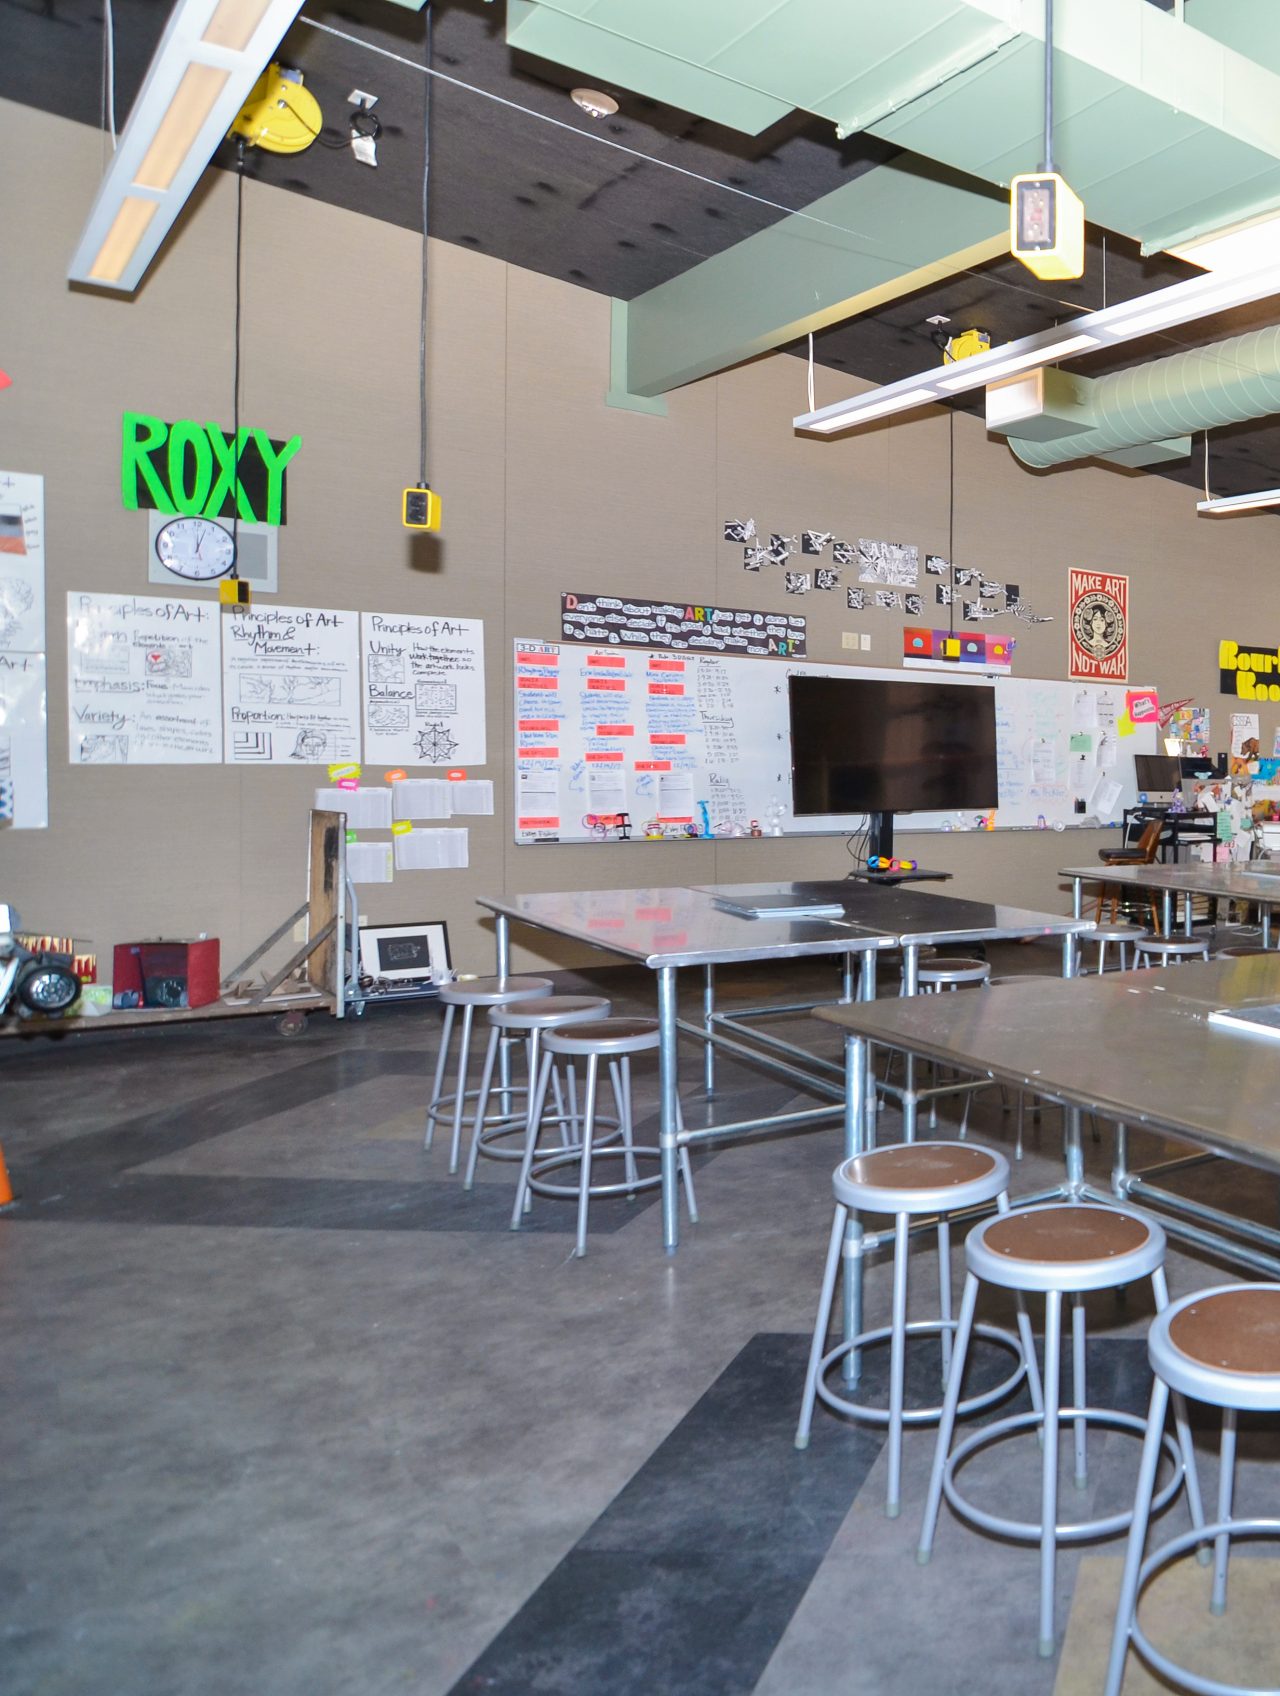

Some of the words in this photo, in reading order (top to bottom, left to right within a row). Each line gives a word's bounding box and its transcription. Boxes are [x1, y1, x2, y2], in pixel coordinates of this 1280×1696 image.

[122, 410, 302, 526] ROXY
[1072, 573, 1102, 604] MAKE
[1104, 578, 1126, 608] ART
[80, 596, 152, 620] Priples
[156, 604, 174, 620] of
[232, 604, 293, 625] Principles
[296, 612, 314, 628] of
[316, 613, 344, 627] Art
[597, 598, 622, 608] think
[623, 606, 650, 614] about
[652, 606, 684, 618] making
[736, 614, 751, 622] get
[231, 624, 281, 646] Rhythm
[282, 626, 296, 640] &
[372, 616, 424, 636] Principles
[424, 621, 440, 637] of
[441, 622, 470, 636] Art
[564, 614, 604, 624] everyone
[606, 614, 626, 622] else
[628, 619, 656, 628] decide
[682, 622, 702, 631] good
[732, 627, 766, 638] whether
[768, 626, 785, 636] they
[788, 630, 804, 639] love
[586, 626, 608, 636] hate
[622, 630, 648, 642] While
[651, 632, 671, 644] they
[724, 637, 747, 645] make
[370, 640, 406, 656] Unity
[428, 654, 459, 664] together
[520, 644, 536, 652] 3-D
[538, 645, 556, 653] ART
[1072, 642, 1098, 673] NOT
[1100, 646, 1125, 676] WAR
[369, 684, 415, 699] Balance
[700, 710, 734, 728] Thursday
